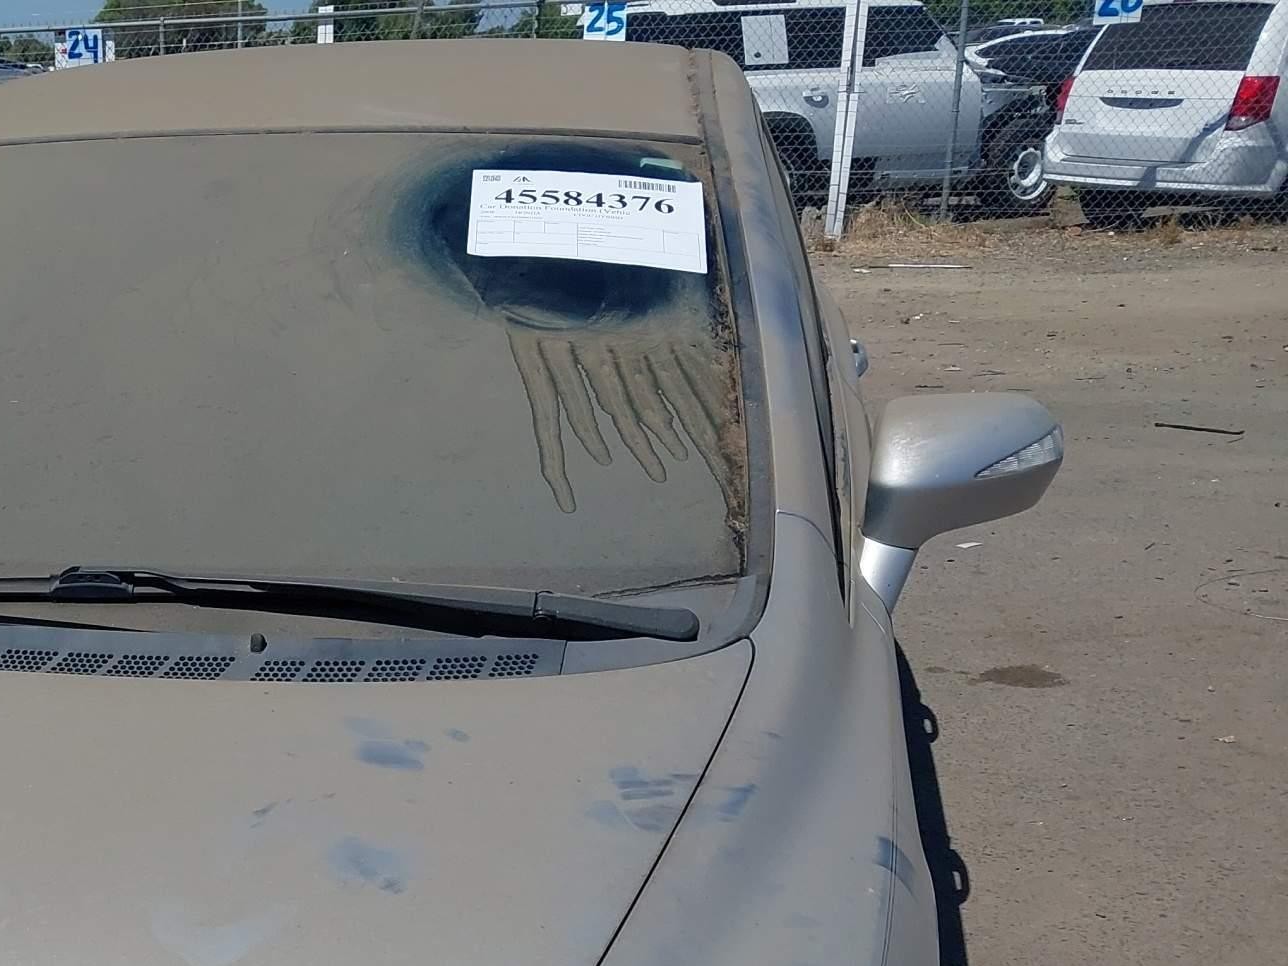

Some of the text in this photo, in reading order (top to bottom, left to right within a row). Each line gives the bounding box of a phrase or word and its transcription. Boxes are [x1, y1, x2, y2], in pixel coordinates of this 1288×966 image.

[587, 3, 625, 36] 25
[68, 30, 99, 64] 24
[495, 189, 674, 214] 45584376
